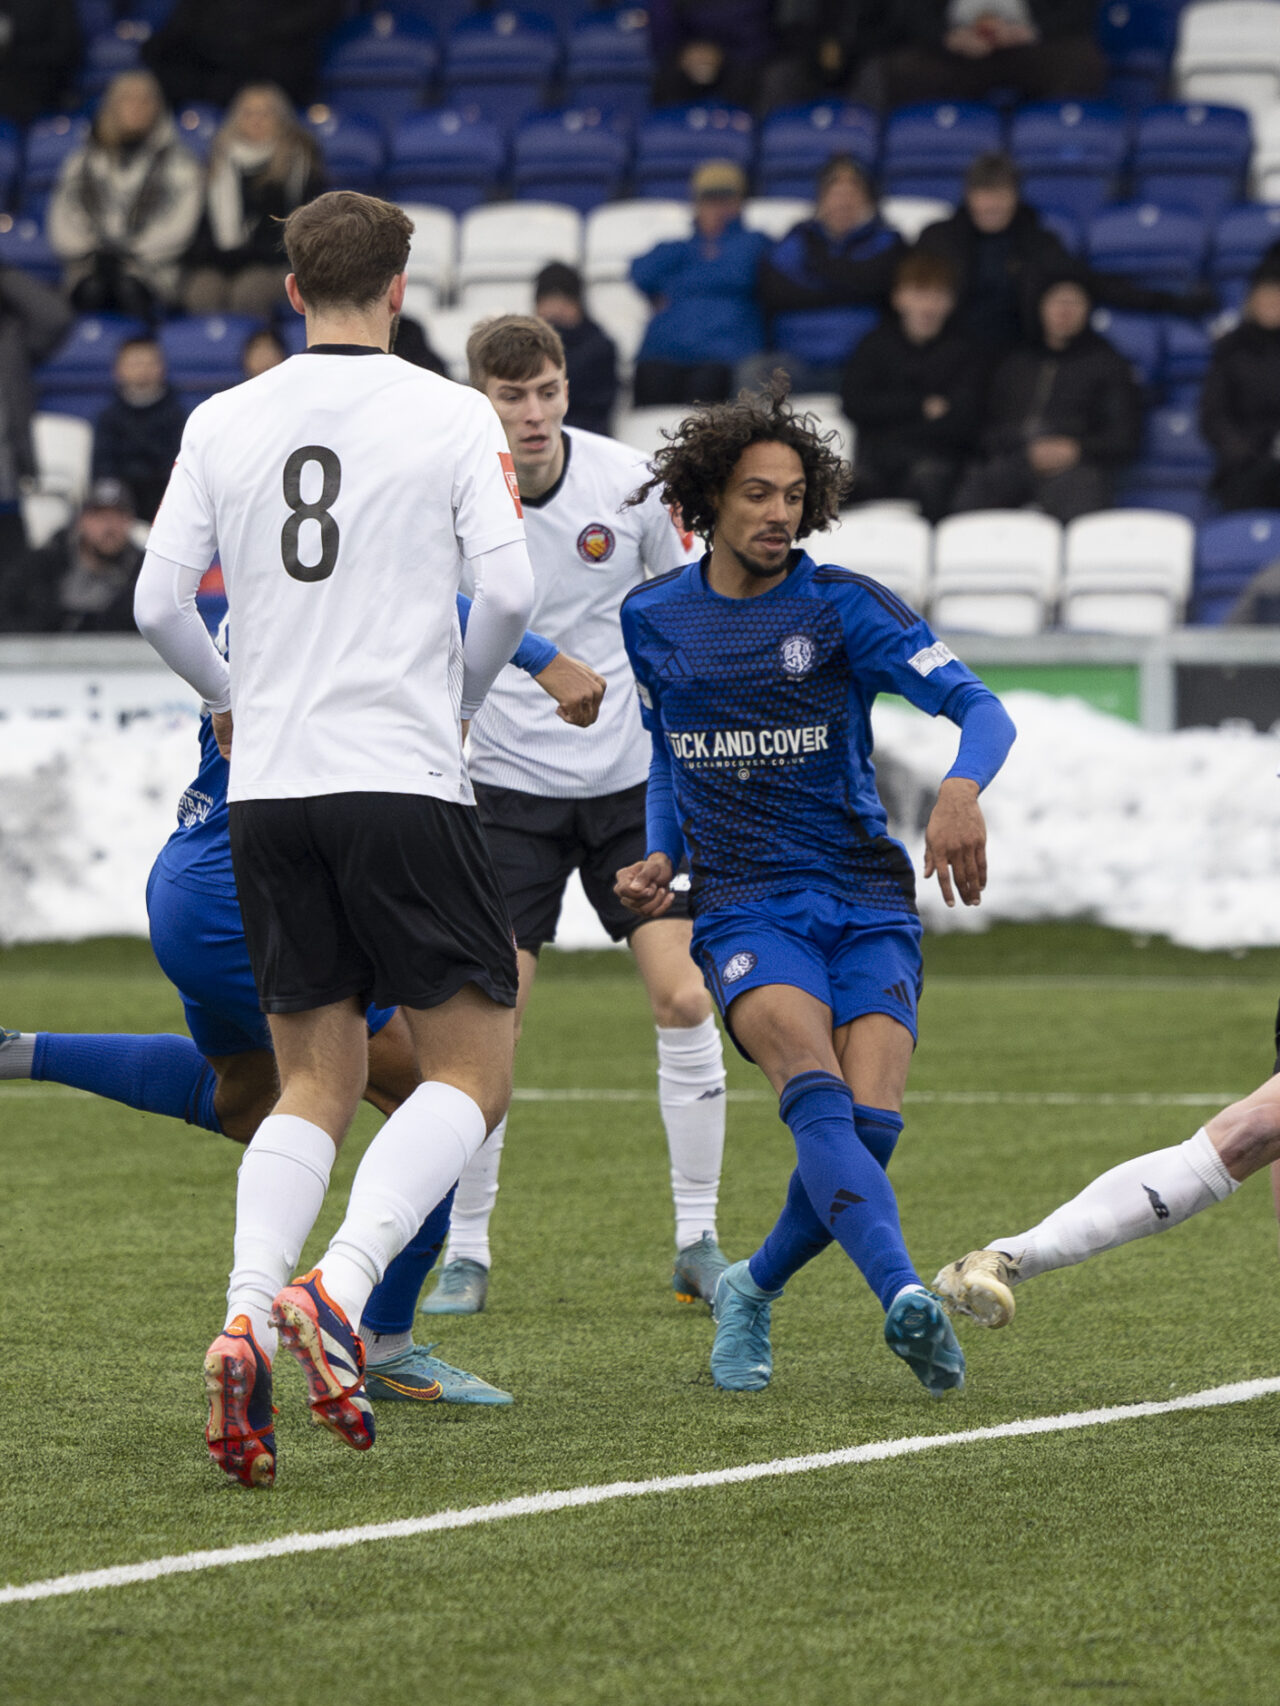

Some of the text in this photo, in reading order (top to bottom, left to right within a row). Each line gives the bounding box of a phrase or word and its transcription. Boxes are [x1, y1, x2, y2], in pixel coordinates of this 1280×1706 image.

[281, 445, 341, 582] 8
[666, 725, 828, 760] UCK AND COVER
